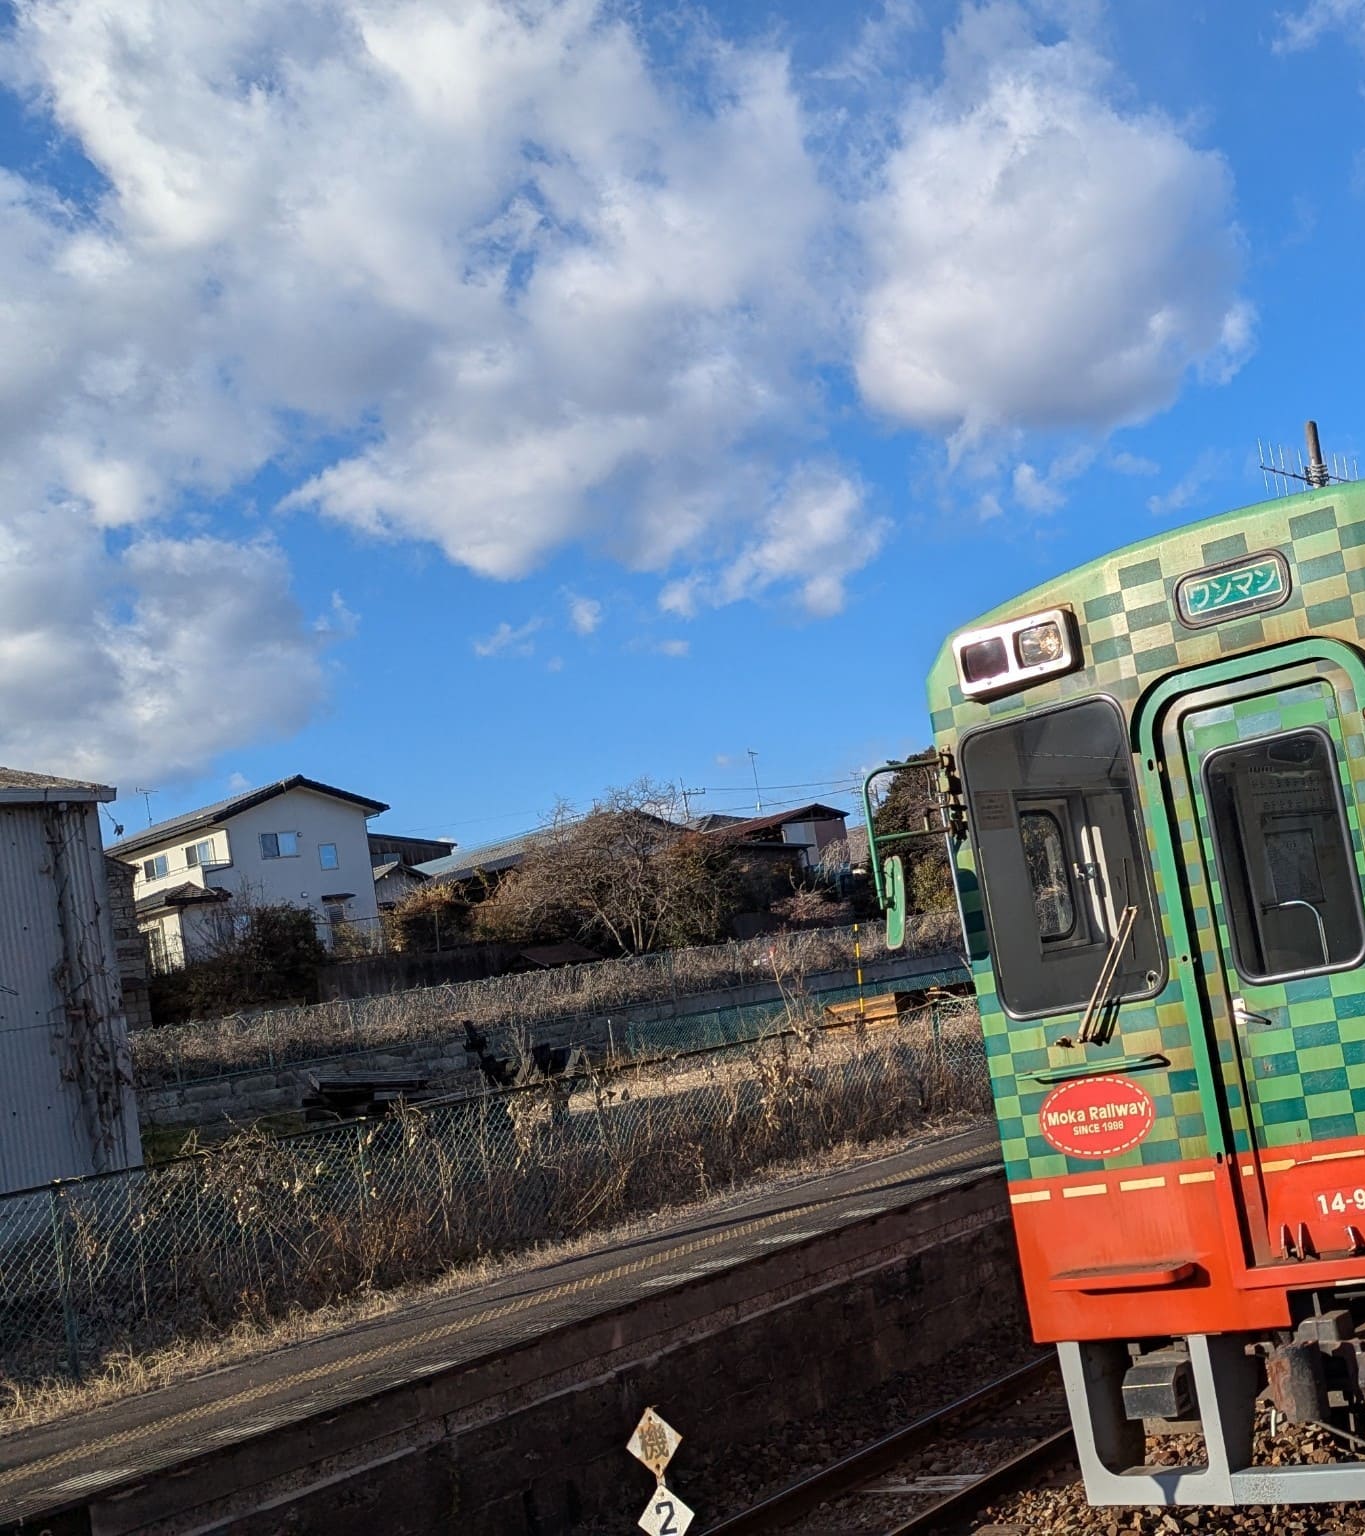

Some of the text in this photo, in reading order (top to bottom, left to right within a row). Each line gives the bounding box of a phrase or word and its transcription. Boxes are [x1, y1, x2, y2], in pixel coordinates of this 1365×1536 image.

[1189, 569, 1276, 609] ワンマン
[1047, 1100, 1147, 1127] Moka Railway
[1073, 1120, 1124, 1136] SINCE 1988
[655, 1500, 678, 1536] 2
